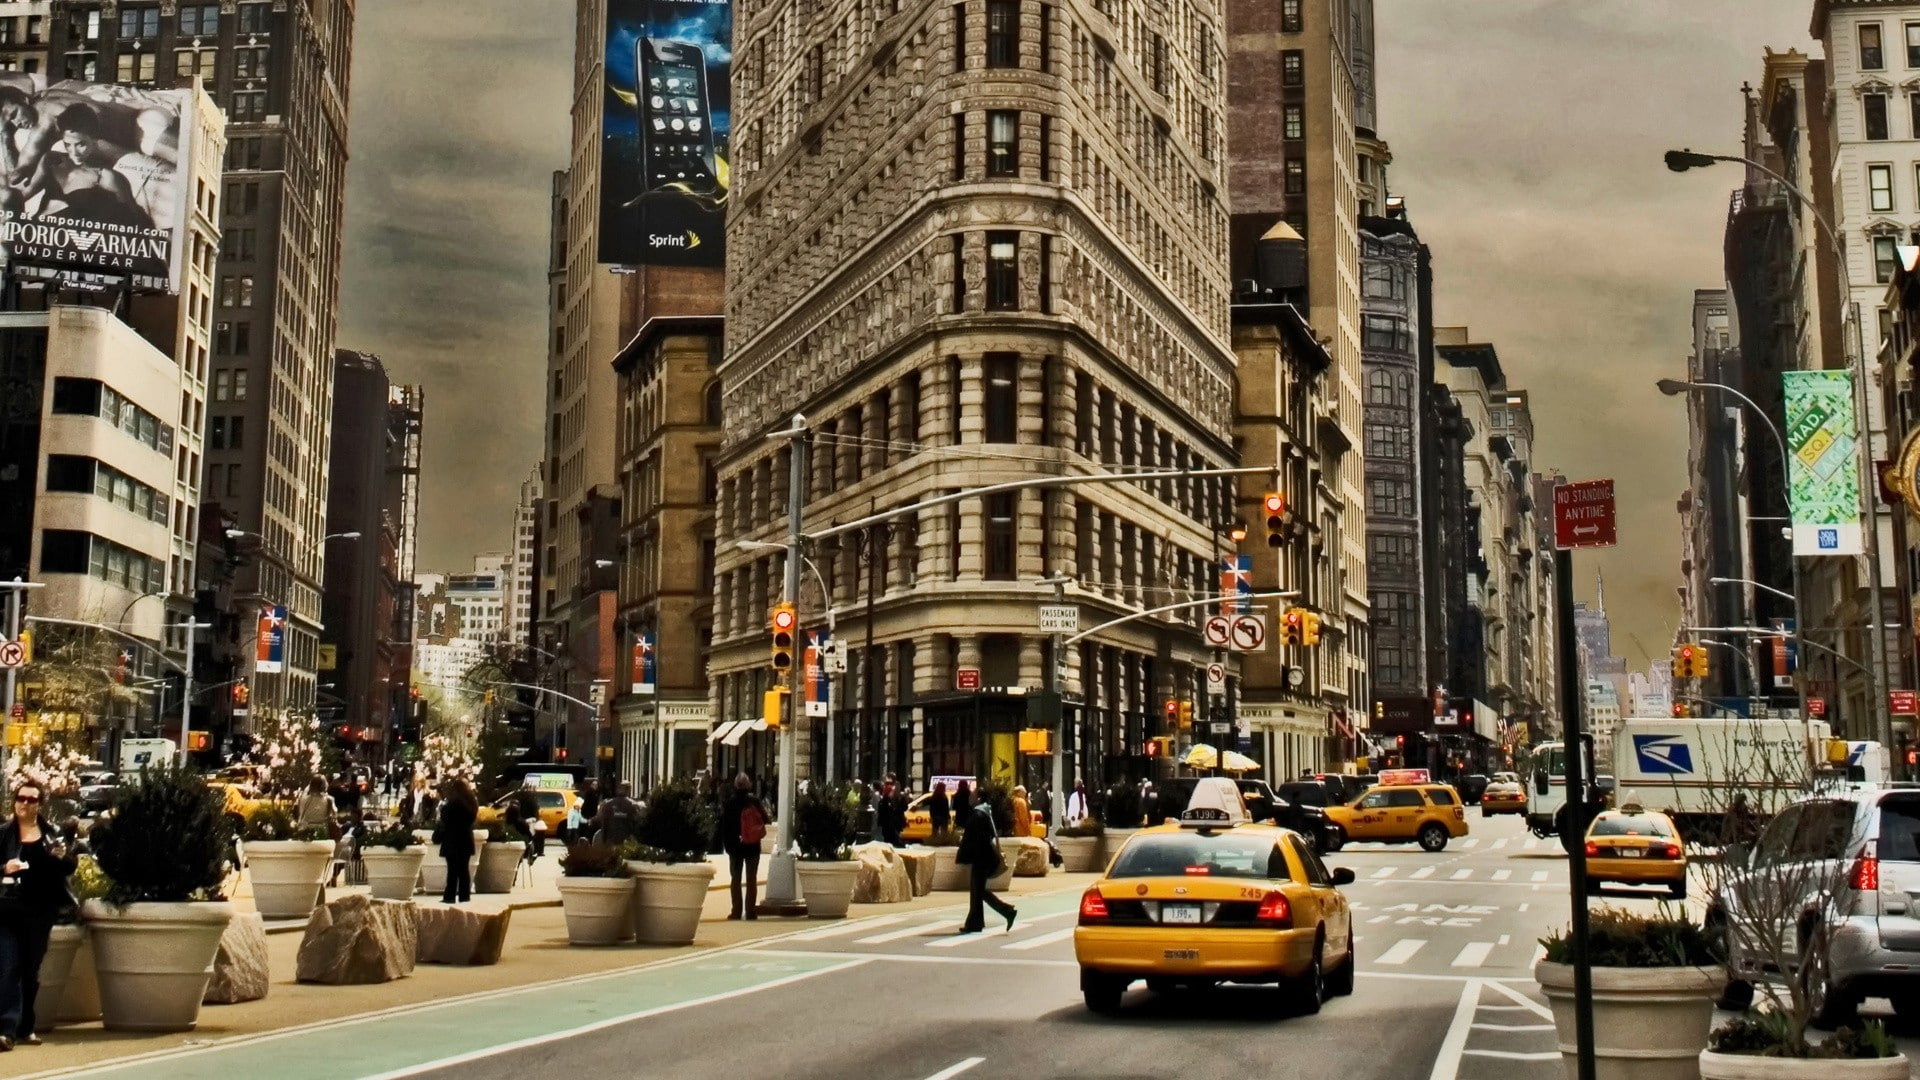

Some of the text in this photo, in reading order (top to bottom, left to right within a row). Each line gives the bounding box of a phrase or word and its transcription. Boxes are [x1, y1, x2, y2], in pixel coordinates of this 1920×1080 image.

[20, 212, 32, 221] at
[39, 215, 169, 238] emporioarmani.com
[94, 233, 168, 260] ARMANI
[649, 234, 685, 248] Sprint
[15, 245, 133, 268] UNDERWEAR
[1788, 413, 1824, 448] MAD.
[1803, 438, 1829, 461] SQ.
[1558, 487, 1610, 504] NO STANDING
[1565, 505, 1605, 520] ANYTIME
[1041, 609, 1076, 618] PASSENGER
[1041, 620, 1076, 628] CARS ONLY
[1195, 810, 1215, 819] 1J90
[1240, 887, 1262, 899] 245
